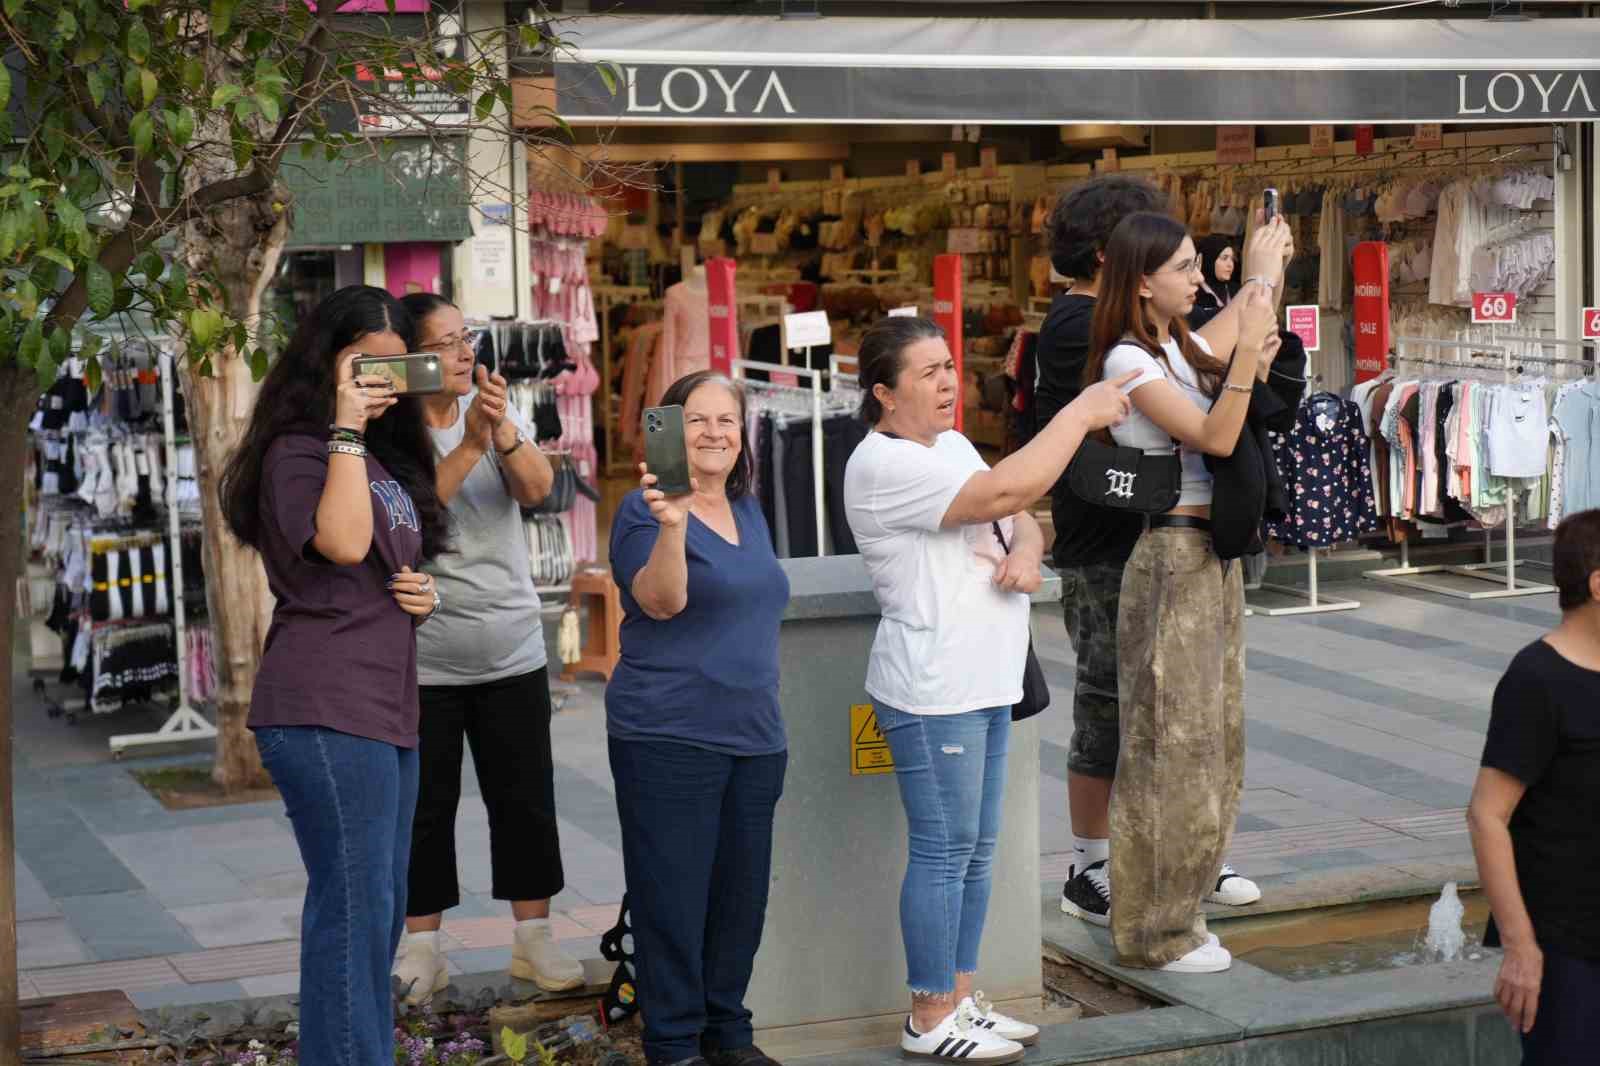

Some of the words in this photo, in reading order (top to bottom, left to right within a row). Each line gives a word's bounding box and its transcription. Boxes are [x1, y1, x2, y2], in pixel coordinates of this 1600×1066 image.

[625, 66, 796, 113] LOYA
[1457, 72, 1597, 114] LOYA
[1481, 297, 1507, 317] 60
[1360, 322, 1377, 334] SALE
